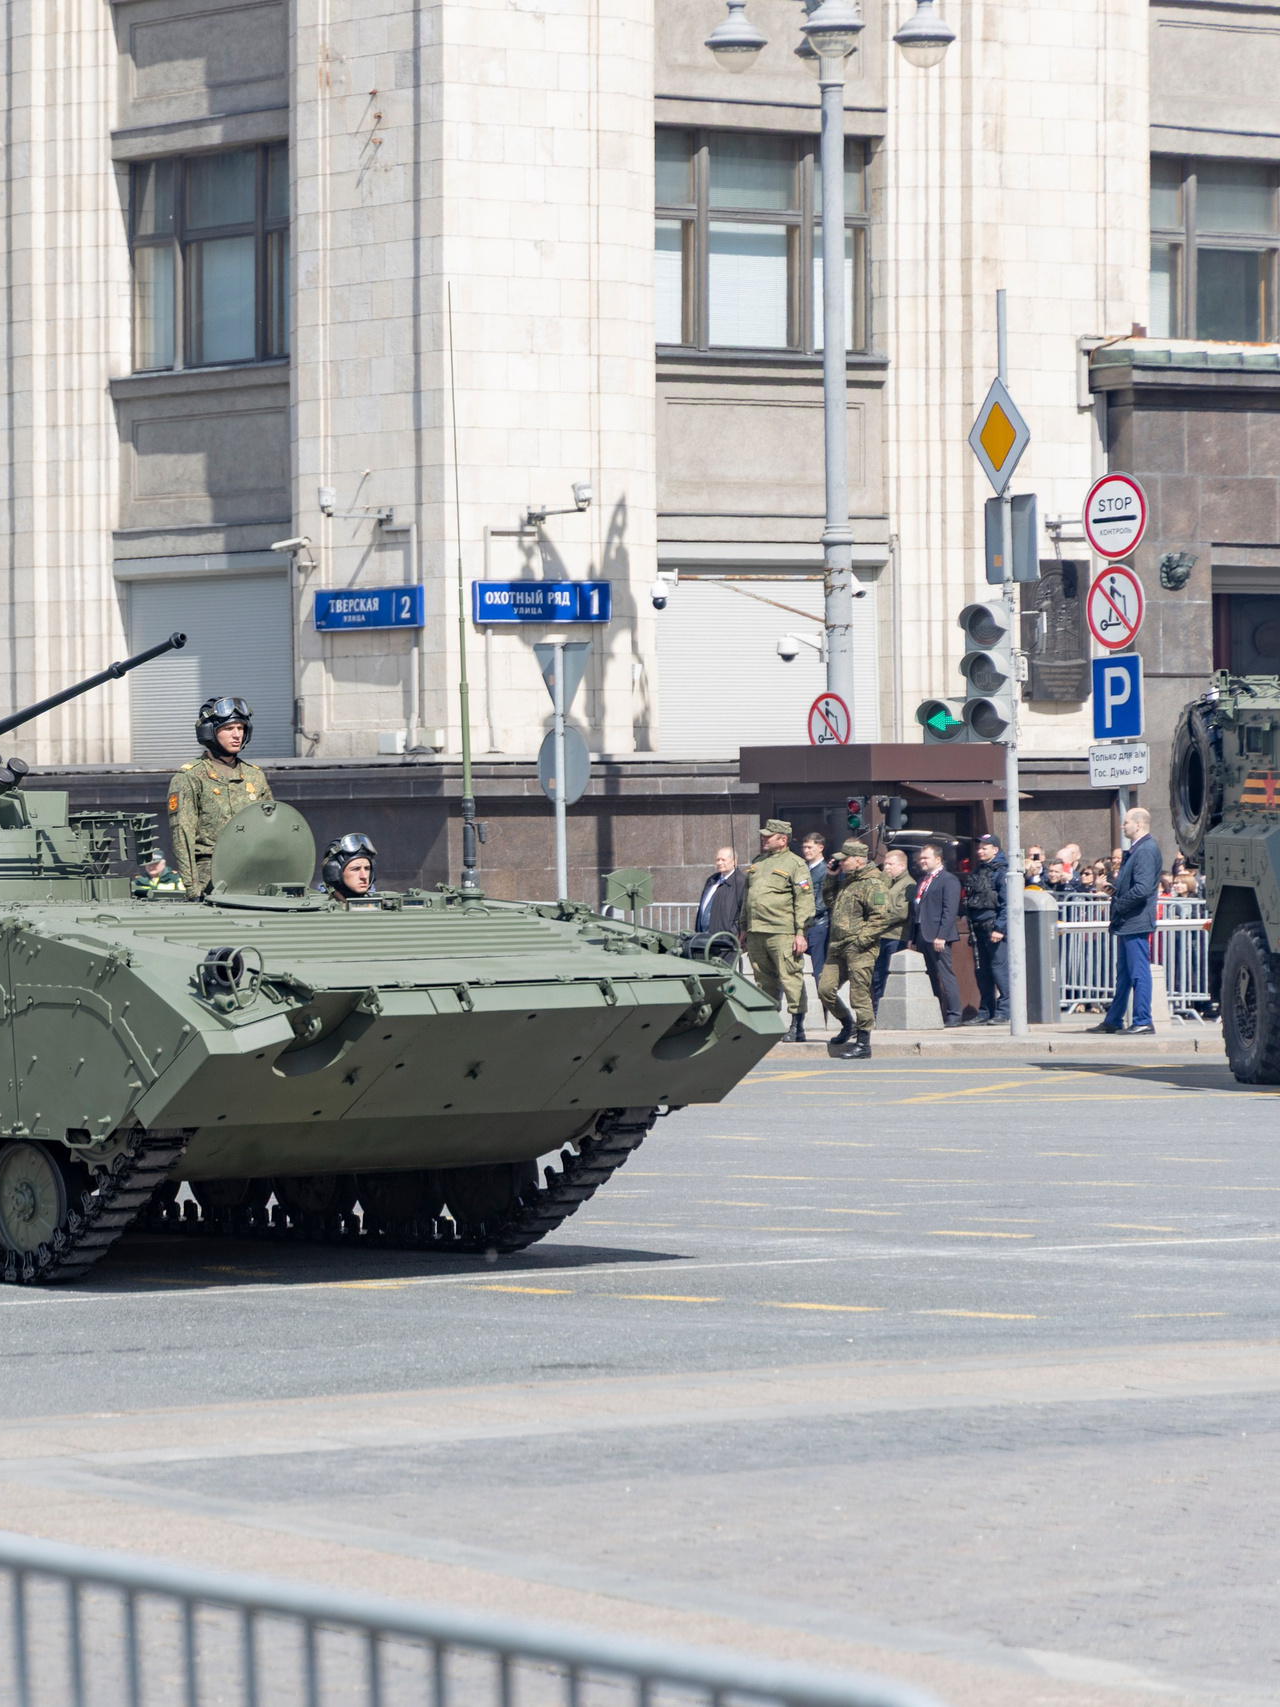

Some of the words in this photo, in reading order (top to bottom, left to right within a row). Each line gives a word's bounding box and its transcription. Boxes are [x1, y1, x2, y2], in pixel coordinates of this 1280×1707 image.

[1098, 496, 1132, 512] STOP
[1099, 527, 1132, 536] КОНТРОЛЬ
[328, 597, 380, 613] ТВЕРСКАЯ
[485, 589, 544, 605] ОХОТНЫЙ
[547, 591, 571, 606] РЯД
[589, 588, 600, 615] 1
[400, 596, 411, 619] 2
[513, 607, 543, 615] УЛИЦА
[343, 614, 366, 622] УЛИЦА
[1104, 666, 1132, 729] P
[1091, 752, 1117, 762] Только
[1118, 751, 1132, 761] для
[1134, 748, 1146, 759] а/м
[1094, 768, 1108, 778] Гос.
[1110, 767, 1131, 778] Думы
[1133, 765, 1144, 774] РФ
